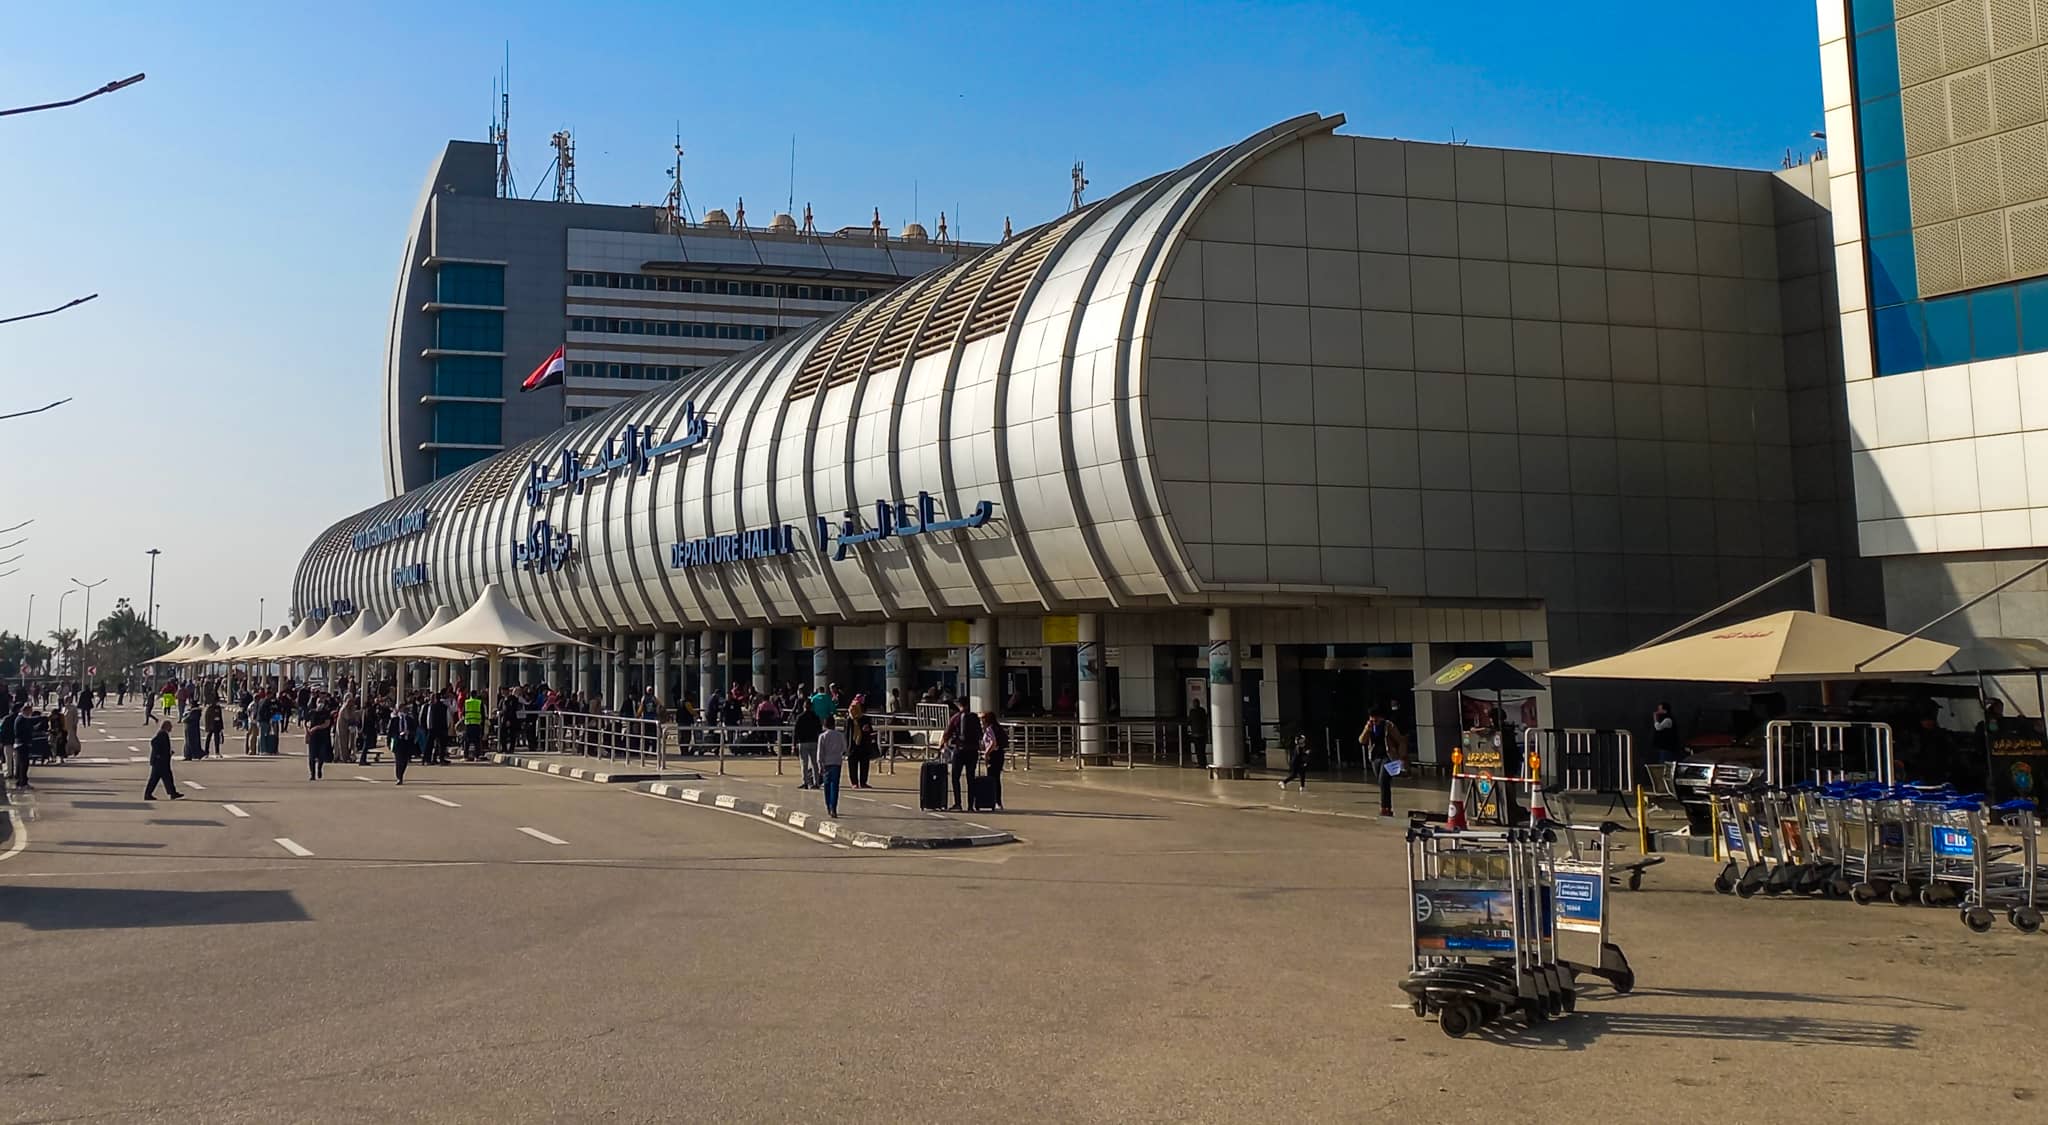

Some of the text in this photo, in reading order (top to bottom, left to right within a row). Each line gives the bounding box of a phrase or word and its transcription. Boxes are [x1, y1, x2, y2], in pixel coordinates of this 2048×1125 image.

[571, 424, 637, 495] القاهرة
[639, 400, 709, 476] مطار
[671, 532, 740, 568] DEPARTURE
[742, 527, 777, 560] HALL
